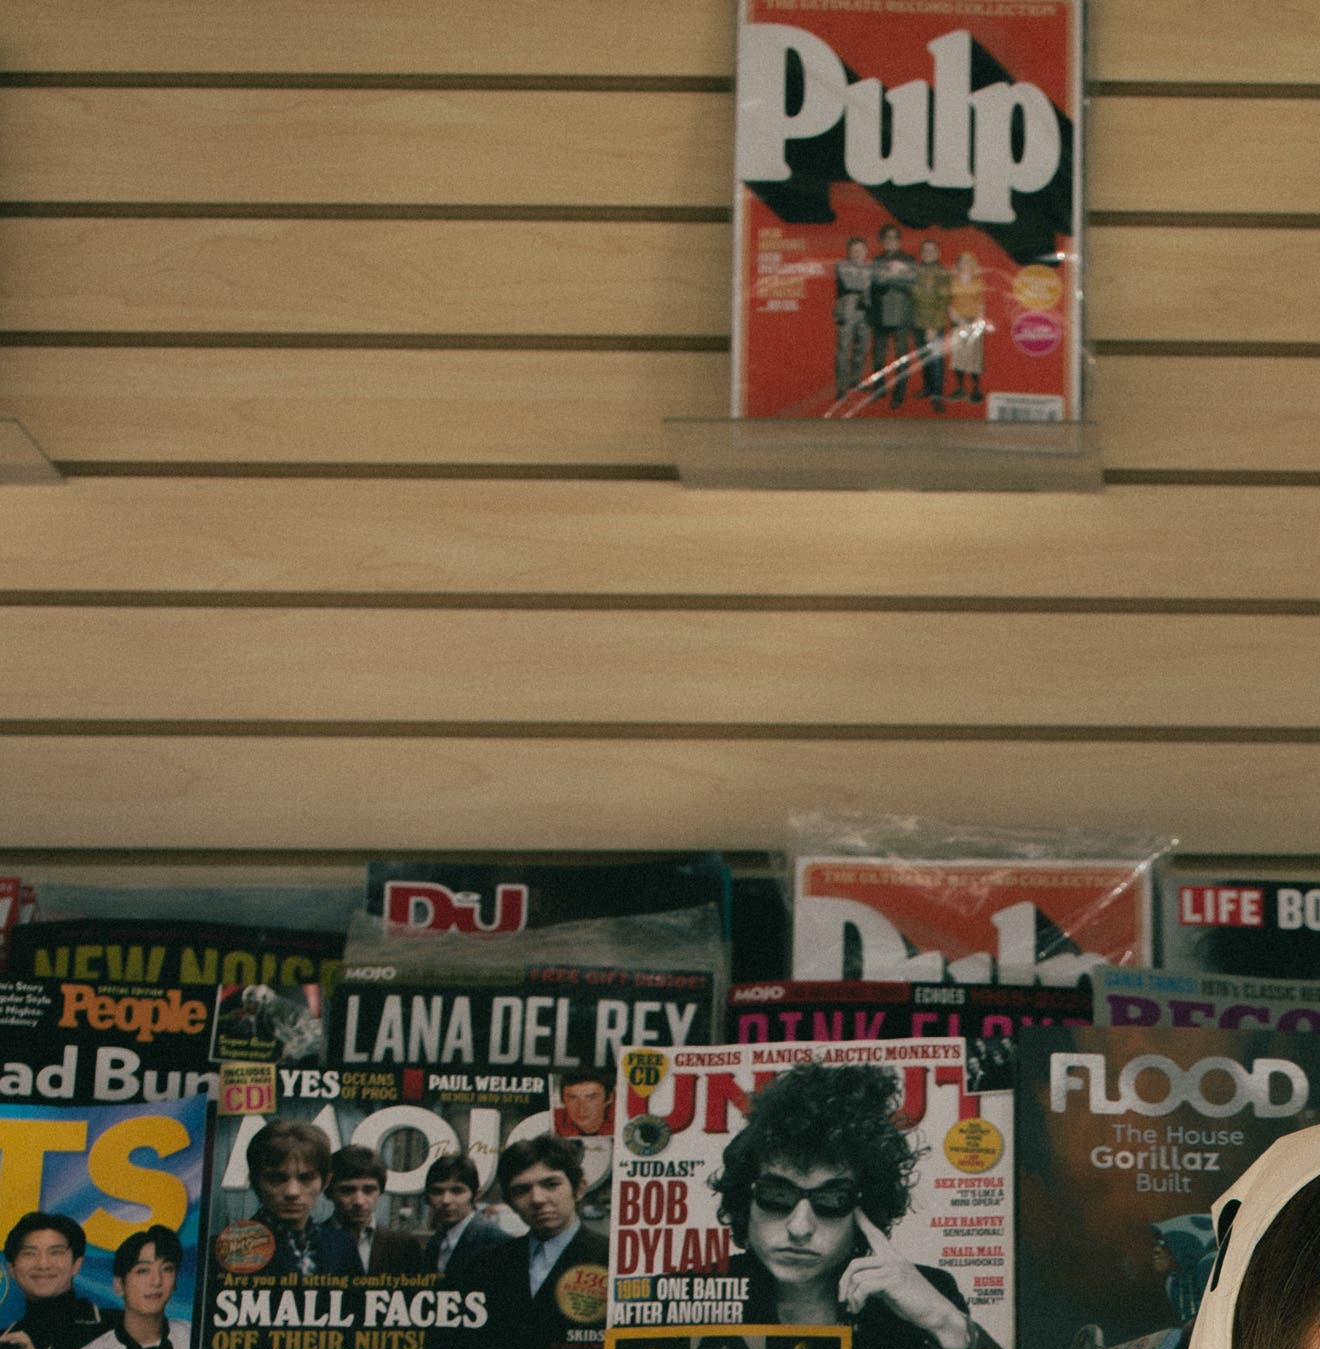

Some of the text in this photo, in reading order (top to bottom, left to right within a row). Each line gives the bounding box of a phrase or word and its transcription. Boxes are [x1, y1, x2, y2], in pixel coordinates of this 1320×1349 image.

[742, 22, 1062, 223] Pulp
[1180, 887, 1264, 926] LIFE
[58, 984, 208, 1042] People
[343, 994, 581, 1066] LANA DEL
[674, 1044, 962, 1068] GENESIS MANICS ARCTIC MONKEYS
[279, 1069, 341, 1098] YES
[428, 1073, 545, 1094] PAUL WELLER
[1049, 1052, 1310, 1119] FLOOD
[225, 1085, 273, 1112] CD!
[1112, 1124, 1245, 1146] The House
[619, 1159, 706, 1179] "JUDAS!"
[1090, 1145, 1221, 1171] Gorillaz
[1135, 1173, 1192, 1195] Built
[618, 1180, 688, 1227] BOB
[616, 1227, 731, 1275] DYLAN
[656, 1277, 750, 1300] ONE BATTLE
[212, 1290, 489, 1329] SMALL FACES
[614, 1301, 744, 1325] AFTER ANOTHER
